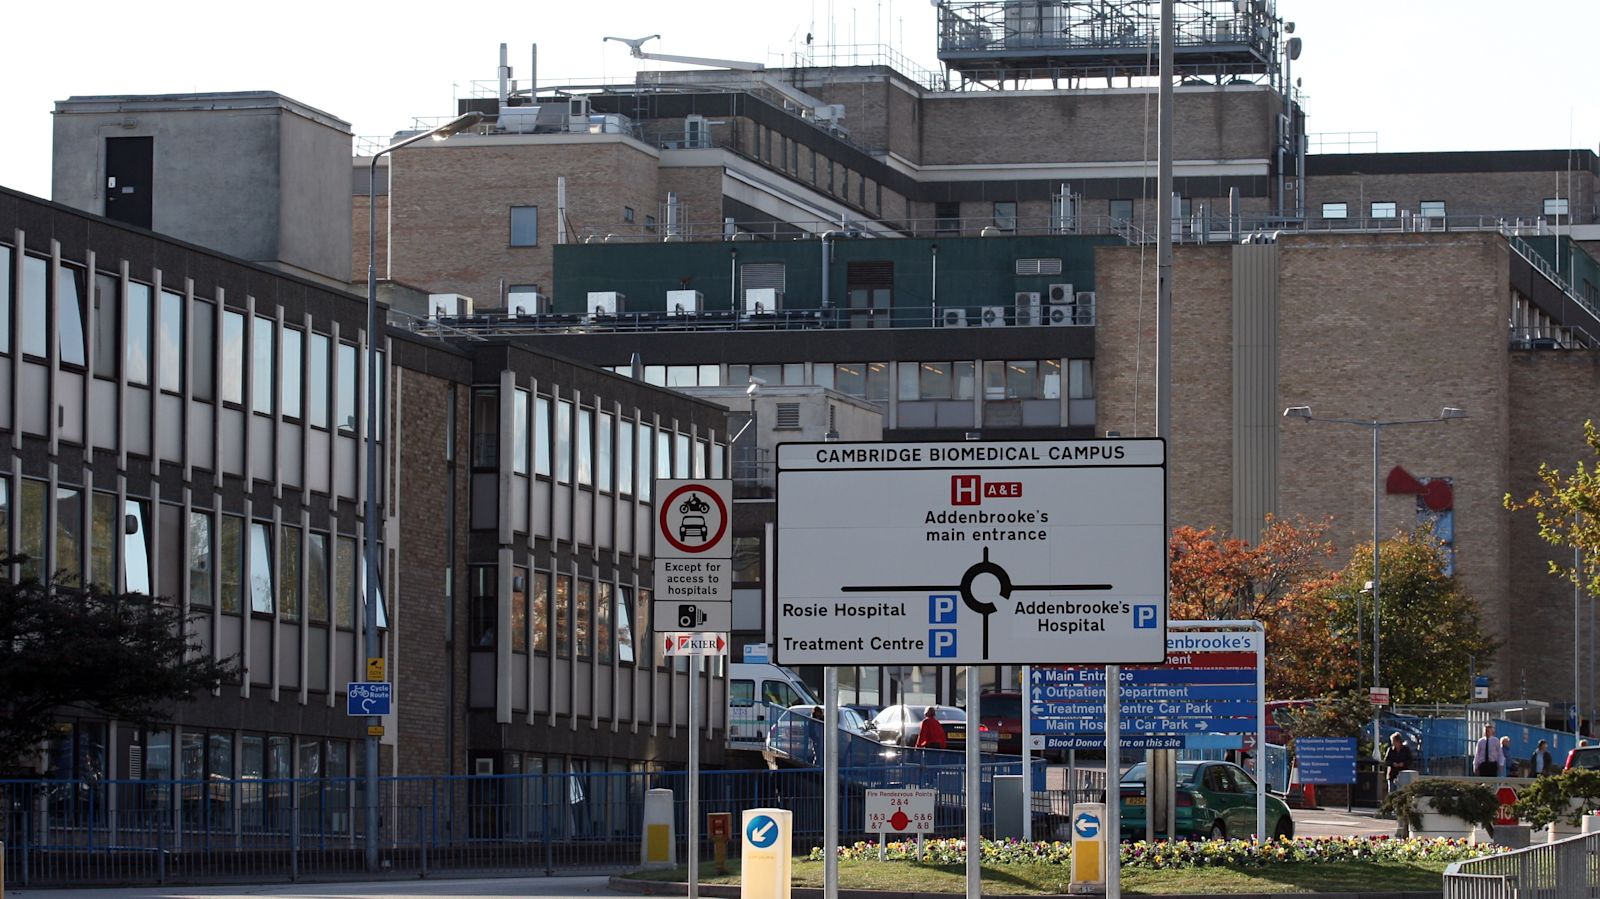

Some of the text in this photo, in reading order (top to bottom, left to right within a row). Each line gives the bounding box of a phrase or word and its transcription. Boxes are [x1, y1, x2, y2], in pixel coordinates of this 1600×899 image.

[816, 445, 1125, 463] CAMBRIDGE BIOMEDICAL CAMPUS
[956, 478, 977, 503] H
[925, 510, 1049, 524] Addenbrooke's
[926, 528, 1047, 541] main entrance
[665, 562, 721, 573] Except for
[667, 574, 719, 583] access to
[668, 585, 718, 596] hospitals
[783, 597, 954, 622] Rosie Hospital P
[1015, 601, 1130, 615] Addenbrooke's
[1138, 607, 1155, 628] P
[1038, 618, 1106, 634] Hospital
[691, 640, 717, 649] KIER
[783, 631, 954, 656] Treatment Centre P
[1167, 635, 1251, 649] enbrooke's
[1046, 670, 1134, 681] Main Entrce
[370, 685, 388, 693] Cycle
[1047, 687, 1106, 699] Outpatien
[1047, 702, 1213, 714] Treatment entre Car Park
[1046, 719, 1189, 732] Main Hosal Car Park
[1048, 738, 1074, 747] Blood
[1075, 738, 1102, 747] Donor
[1104, 739, 1131, 747] tre
[1146, 738, 1162, 747] this
[1164, 738, 1181, 747] site
